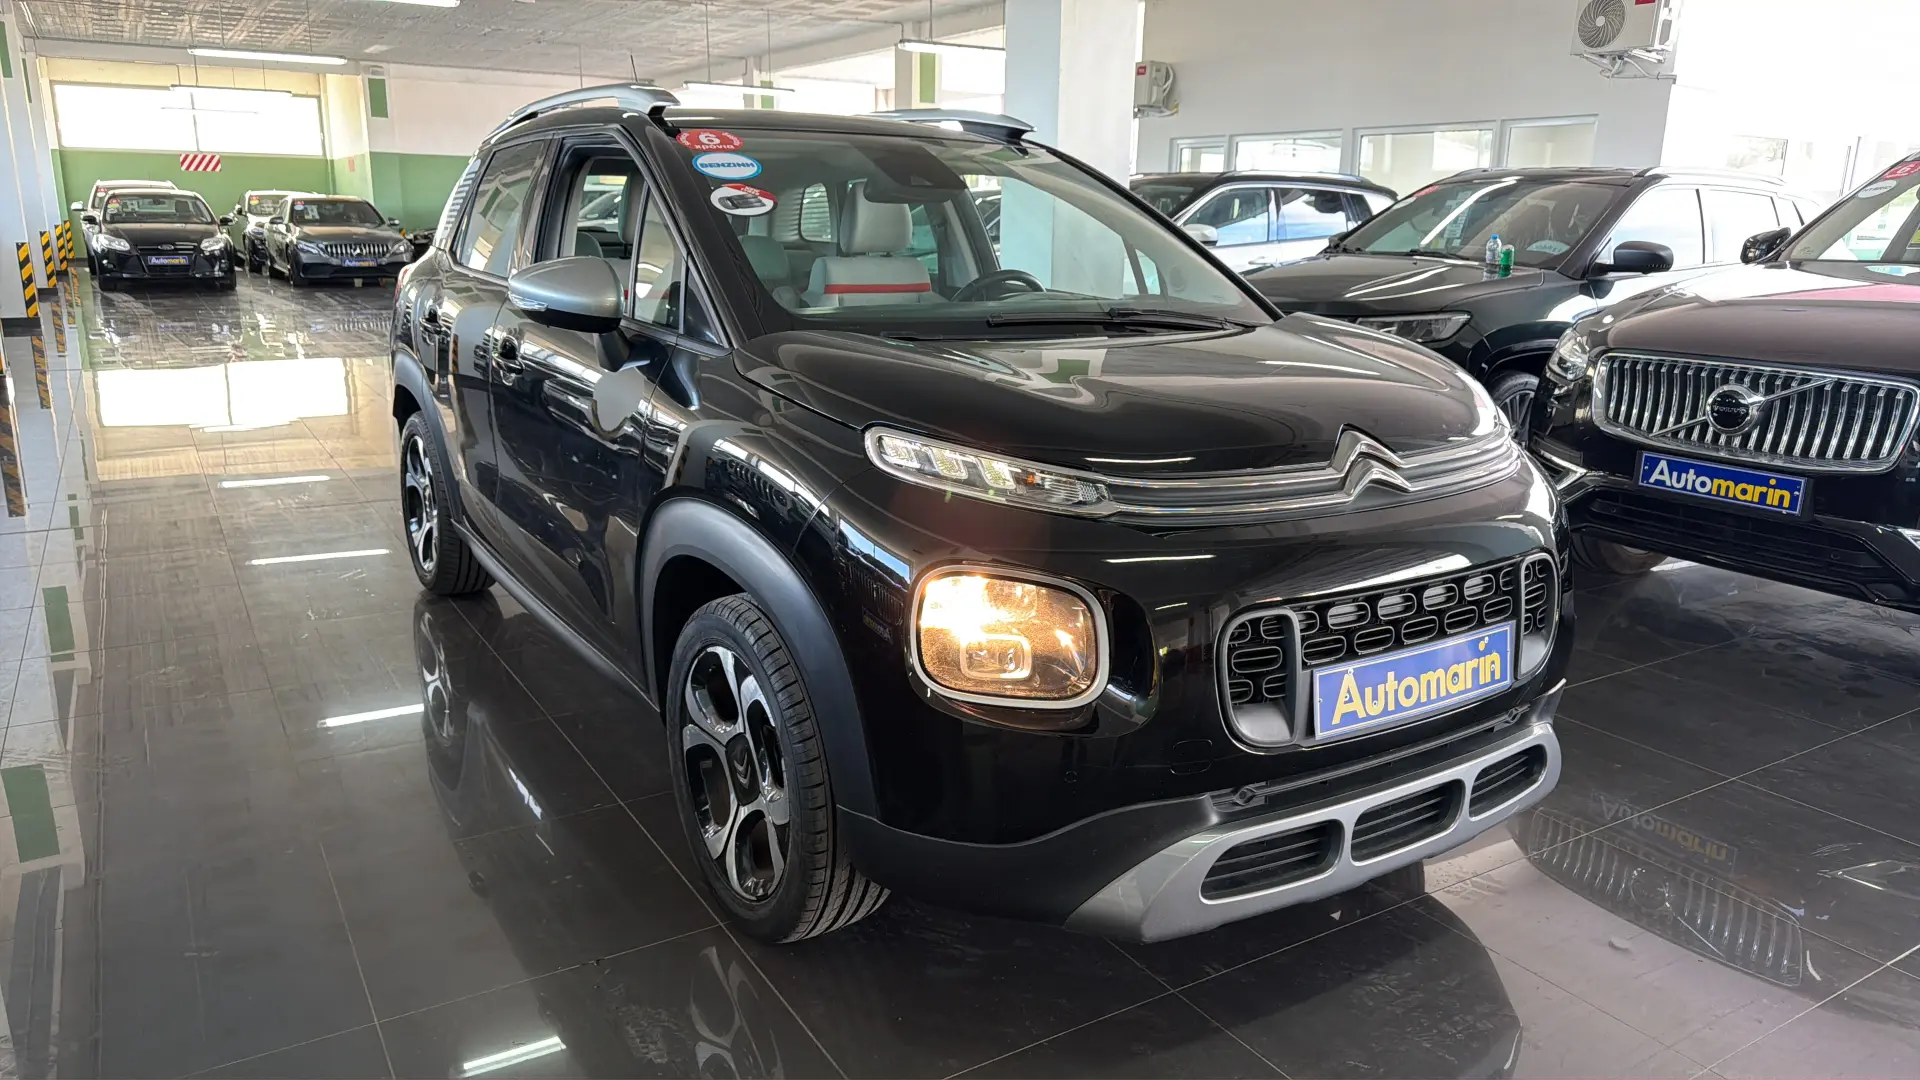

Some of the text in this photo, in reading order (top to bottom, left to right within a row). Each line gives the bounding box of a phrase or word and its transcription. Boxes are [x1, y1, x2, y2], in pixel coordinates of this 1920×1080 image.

[698, 132, 720, 145] 6
[1712, 404, 1747, 413] VOLVO
[1648, 459, 1791, 509] Automarin
[1331, 640, 1501, 726] Automarin
